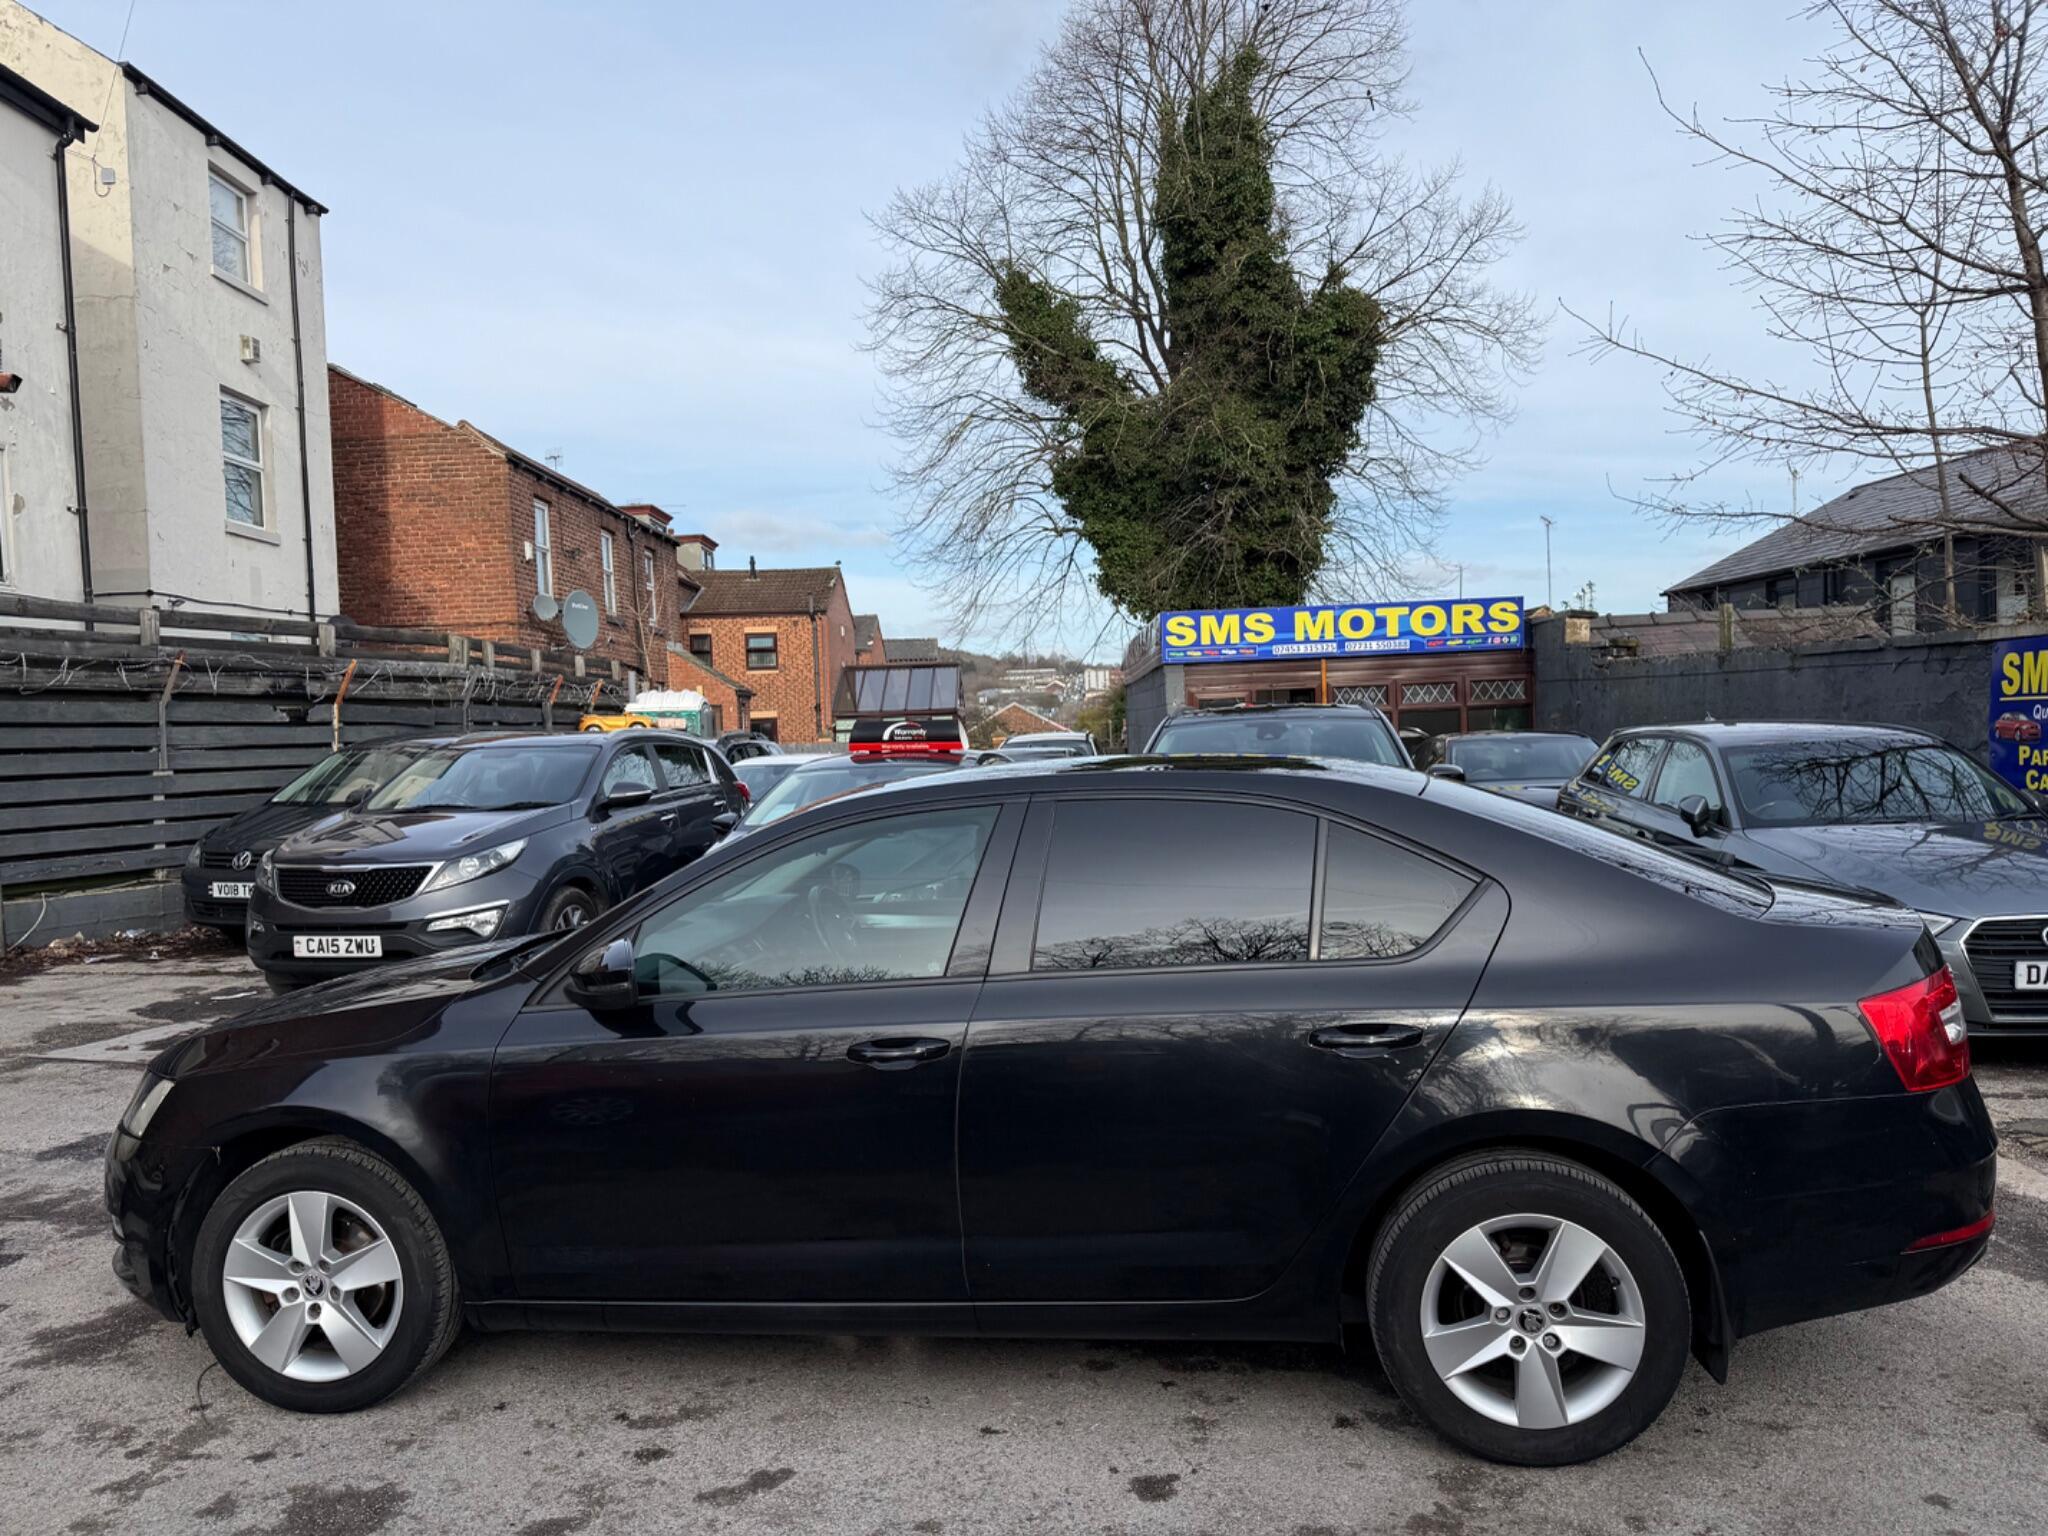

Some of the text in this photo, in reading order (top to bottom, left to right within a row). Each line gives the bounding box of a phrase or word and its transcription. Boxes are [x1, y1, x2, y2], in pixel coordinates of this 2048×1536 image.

[1165, 602, 1520, 646] SMS MOTORS
[329, 883, 350, 893] KIA
[306, 938, 340, 954] CA15
